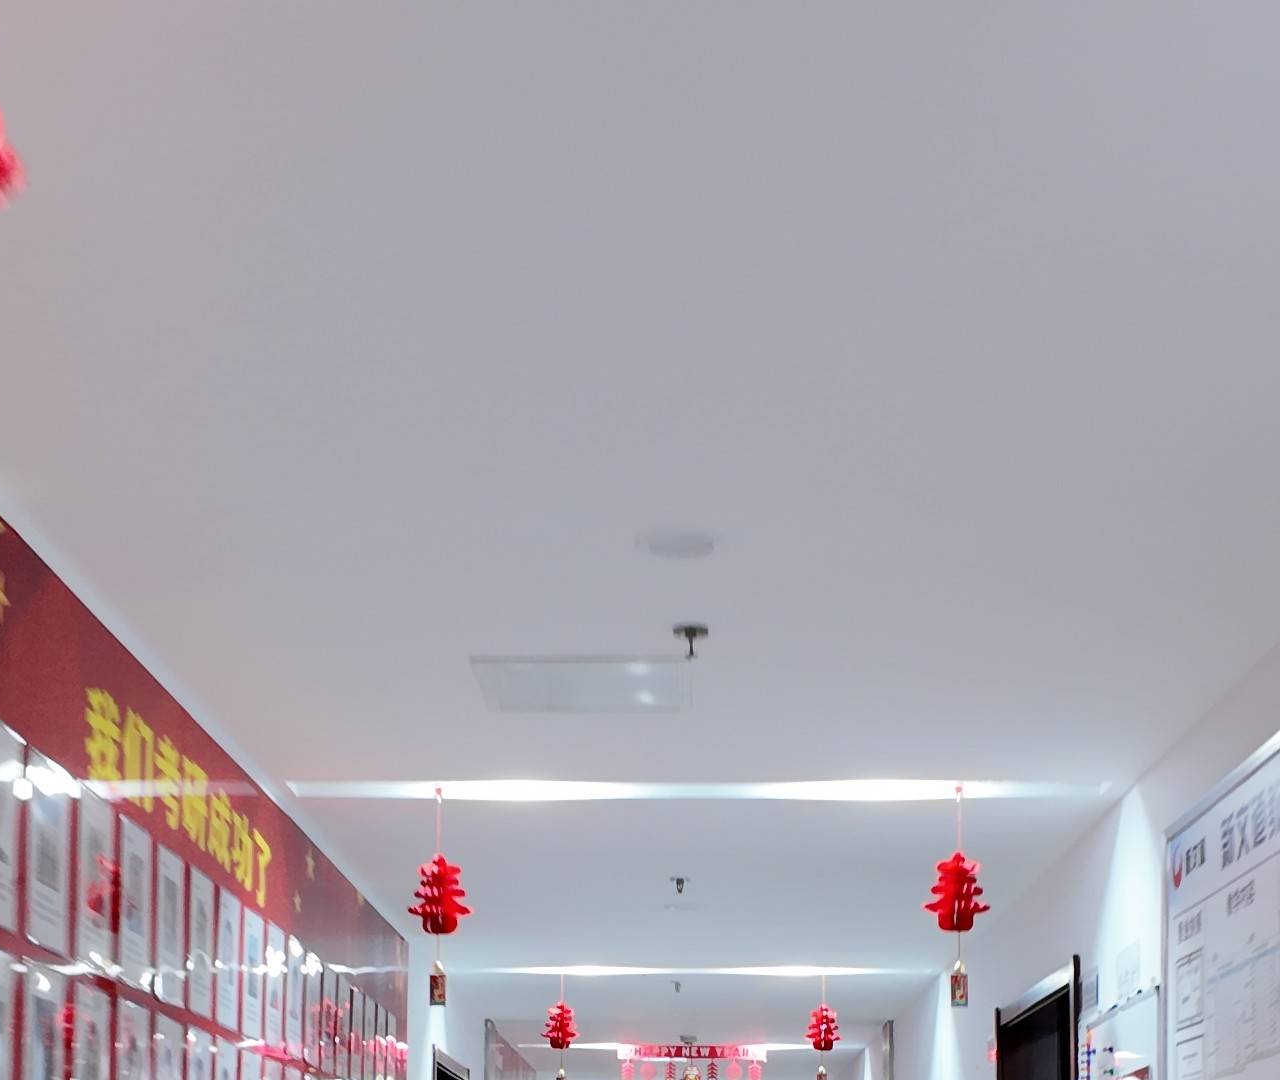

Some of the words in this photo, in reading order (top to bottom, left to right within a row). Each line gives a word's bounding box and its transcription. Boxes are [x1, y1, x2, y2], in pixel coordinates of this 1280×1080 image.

[85, 688, 272, 908] 我们考研成功了
[682, 1046, 709, 1058] NEW
